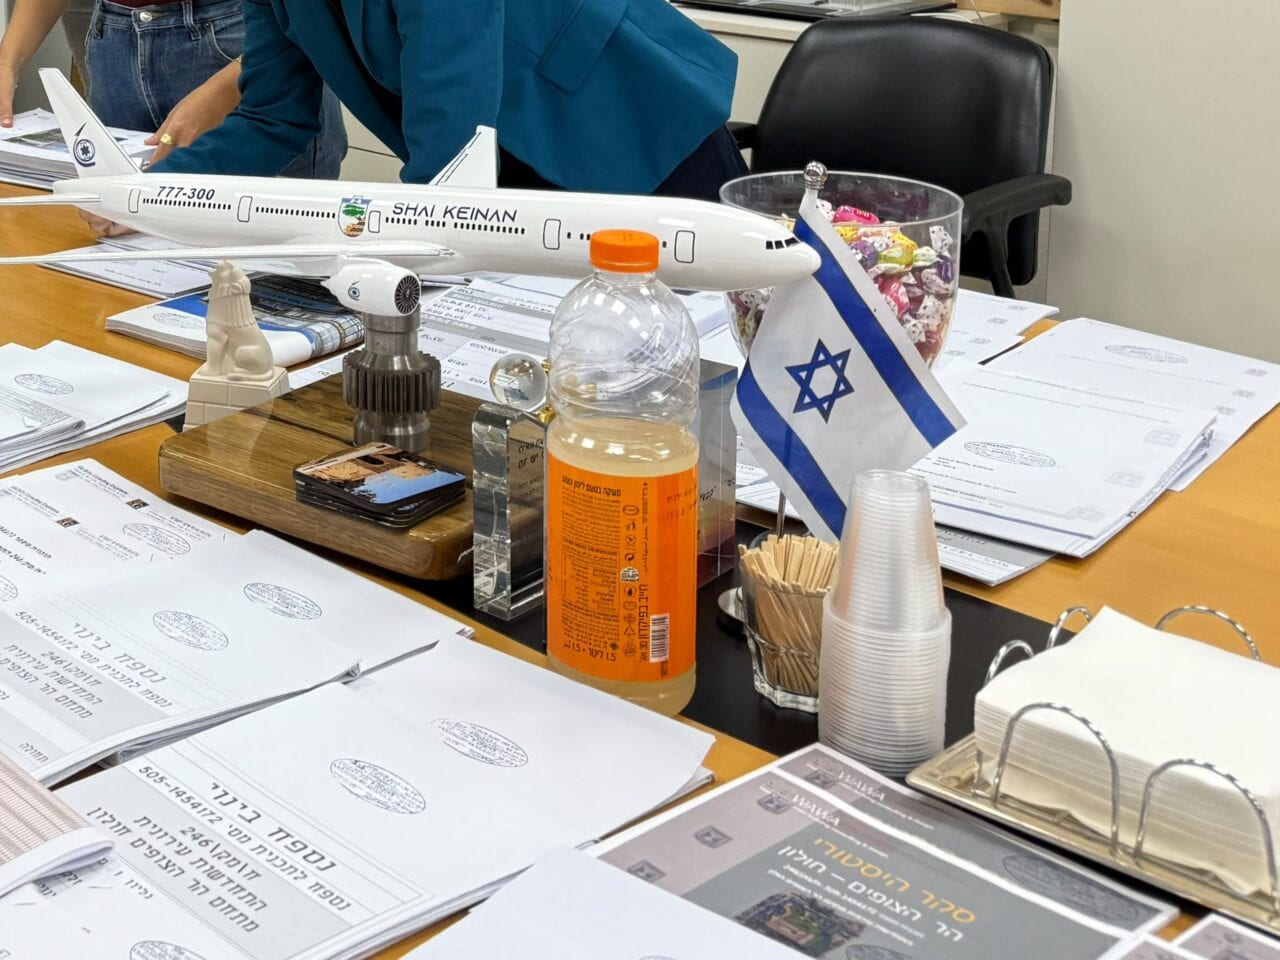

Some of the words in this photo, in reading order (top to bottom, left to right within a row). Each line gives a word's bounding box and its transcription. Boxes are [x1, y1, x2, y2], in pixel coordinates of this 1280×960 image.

[157, 185, 216, 201] 777-300
[392, 202, 436, 219] SHAI
[443, 206, 517, 223] KEINAN
[639, 584, 649, 602] חייב
[15, 610, 78, 651] 505-1454172
[639, 604, 649, 639] בפיקדון
[72, 623, 112, 652] בינוי
[639, 641, 648, 650] 30
[4, 643, 48, 670] עירונית
[115, 653, 169, 683] נספח
[588, 647, 605, 659] ליטר
[40, 682, 57, 696] הר
[45, 670, 103, 705] התחדשות
[98, 663, 141, 688] לתכנית
[54, 693, 93, 719] מתחם
[138, 685, 173, 708] נספח
[138, 766, 223, 825] 505-1454172
[838, 771, 886, 802] WAWA
[204, 782, 262, 825] בינוי
[791, 794, 841, 827] WAWA
[87, 807, 133, 836] חולון
[133, 815, 193, 857] עירונית
[130, 837, 186, 878] הצופים
[251, 844, 308, 882] לתכנית
[268, 827, 338, 872] נספח
[777, 845, 828, 874] חולון
[815, 838, 911, 893] היסטורי
[187, 878, 210, 897] הר
[190, 857, 267, 912] התחדשות
[308, 881, 352, 911] נספח
[209, 895, 260, 933] מתחם
[847, 880, 923, 922] הצופים
[921, 890, 977, 924] סקר
[936, 921, 964, 942] הר
